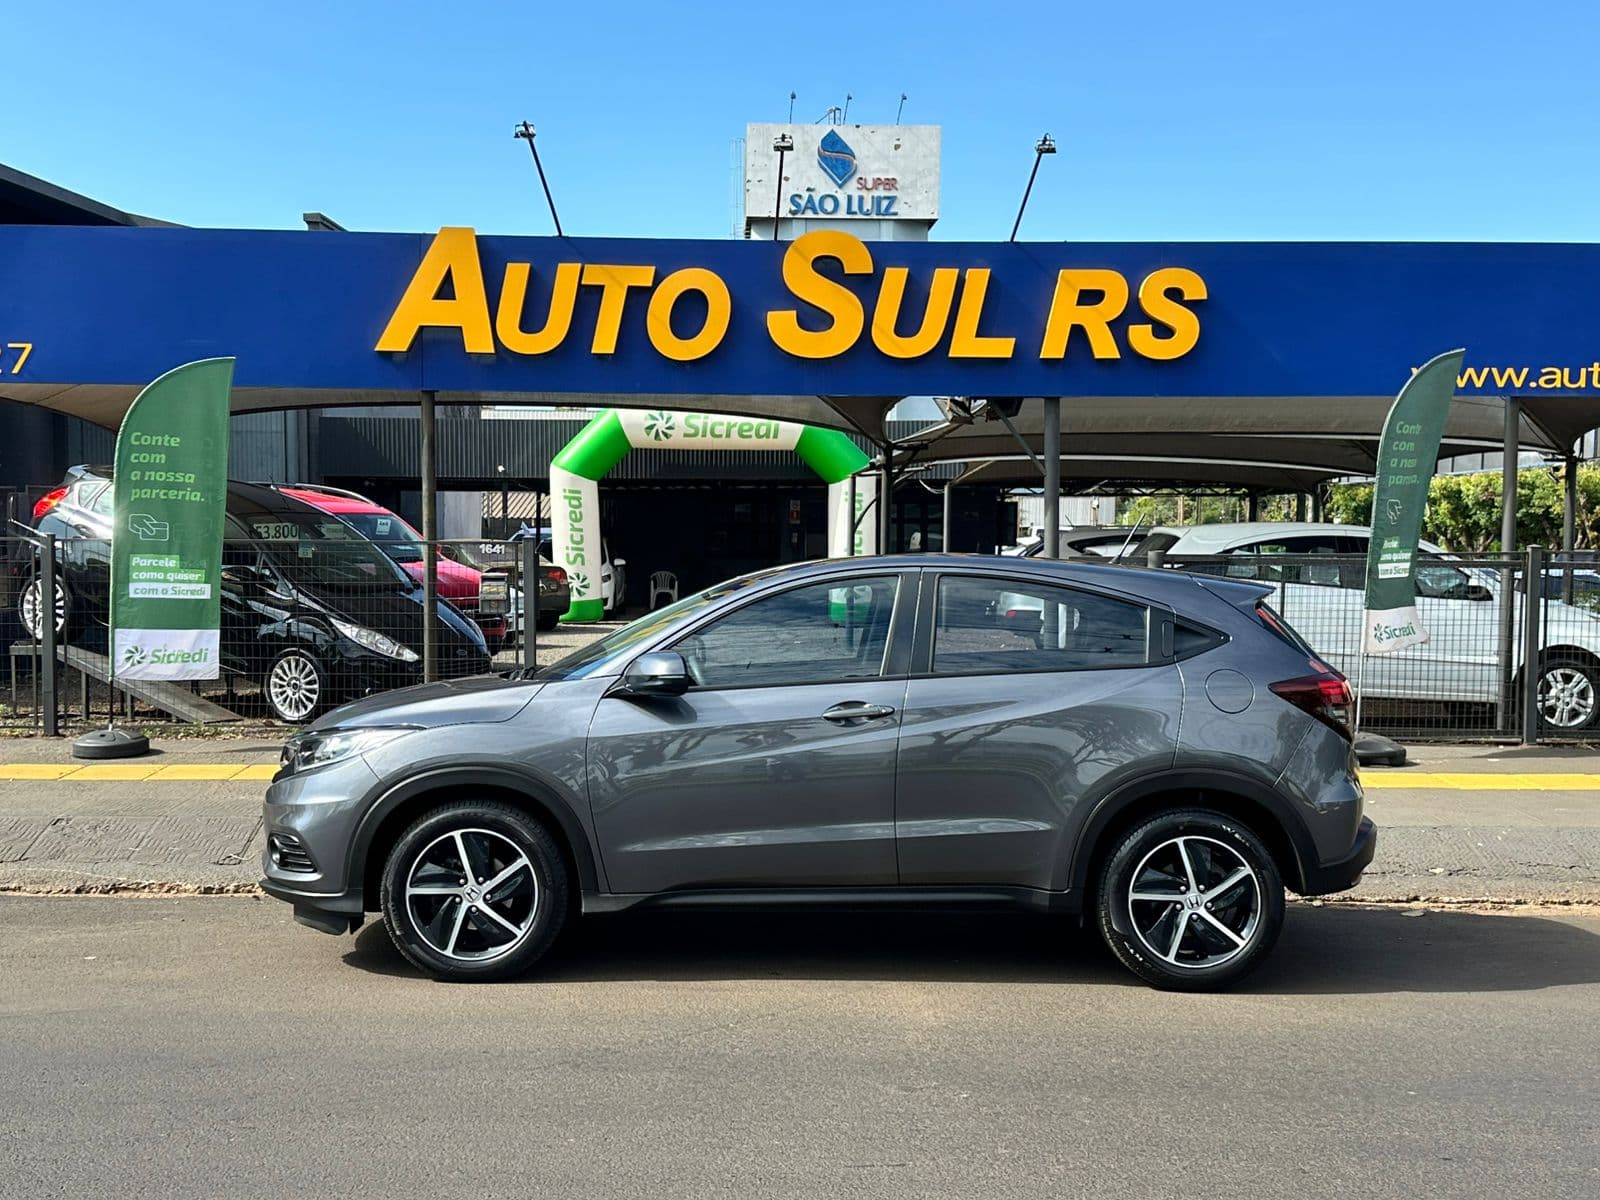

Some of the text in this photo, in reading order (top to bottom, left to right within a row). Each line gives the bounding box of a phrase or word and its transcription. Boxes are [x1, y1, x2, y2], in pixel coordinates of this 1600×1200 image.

[856, 176, 898, 191] SUPER
[789, 187, 898, 216] SÃO LUIZ
[374, 227, 1208, 361] AUTO SUL RS
[0, 343, 33, 374] 7
[1410, 362, 1600, 388] ww.aut
[130, 432, 180, 447] Conte
[130, 452, 166, 463] com
[130, 470, 195, 483] a nossa
[130, 488, 205, 501] parceria.
[563, 488, 586, 567] Sicredi
[479, 543, 506, 554] 1641
[131, 557, 177, 568] Parcele
[132, 570, 202, 582] como quiser
[133, 585, 206, 596] com o Sicredi
[150, 647, 209, 664] Sicredi
